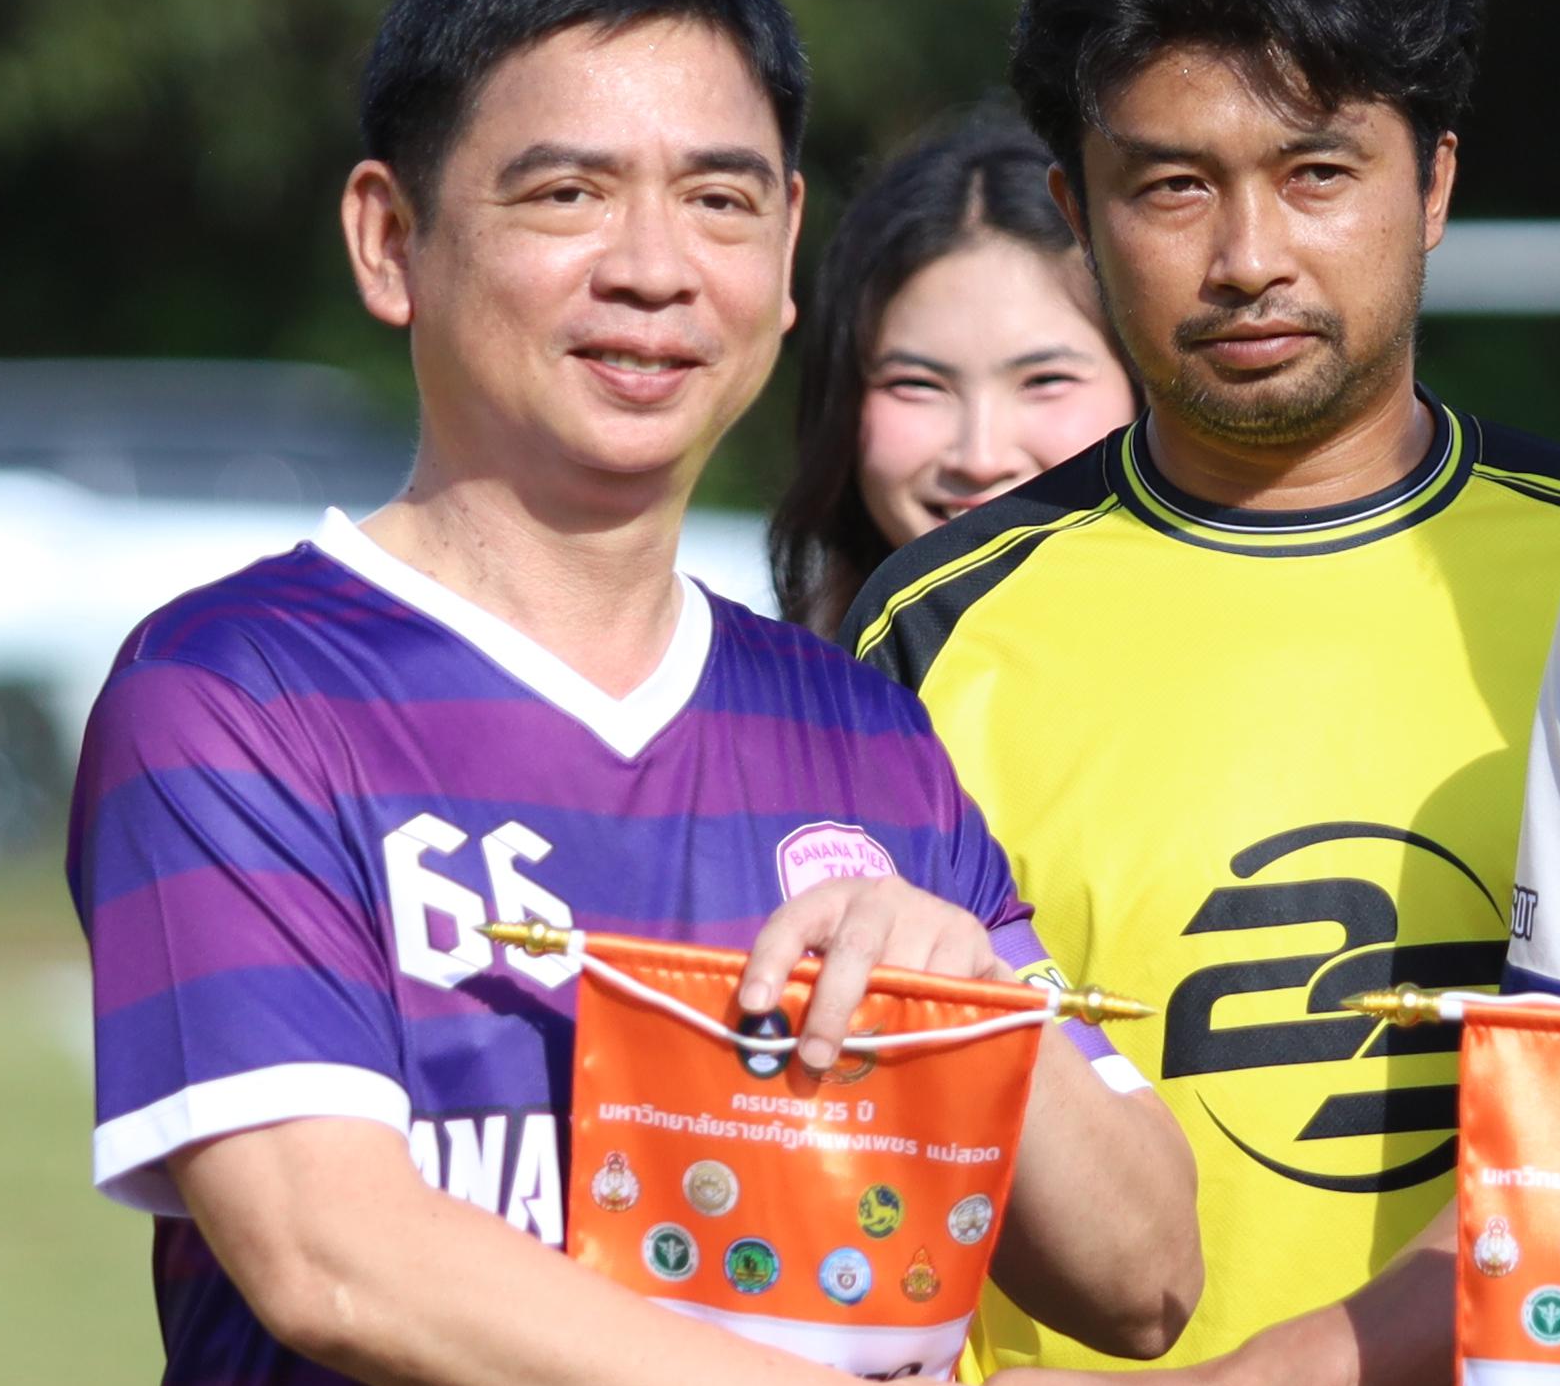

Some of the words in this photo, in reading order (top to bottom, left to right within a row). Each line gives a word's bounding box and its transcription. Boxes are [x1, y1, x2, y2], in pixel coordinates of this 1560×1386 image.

[790, 840, 853, 867] BANANA
[382, 812, 584, 990] 66
[731, 1091, 818, 1119] ครบรอบ
[822, 1098, 848, 1121] 25
[856, 1098, 876, 1123] ปี
[926, 1140, 1001, 1165] แม่สอด
